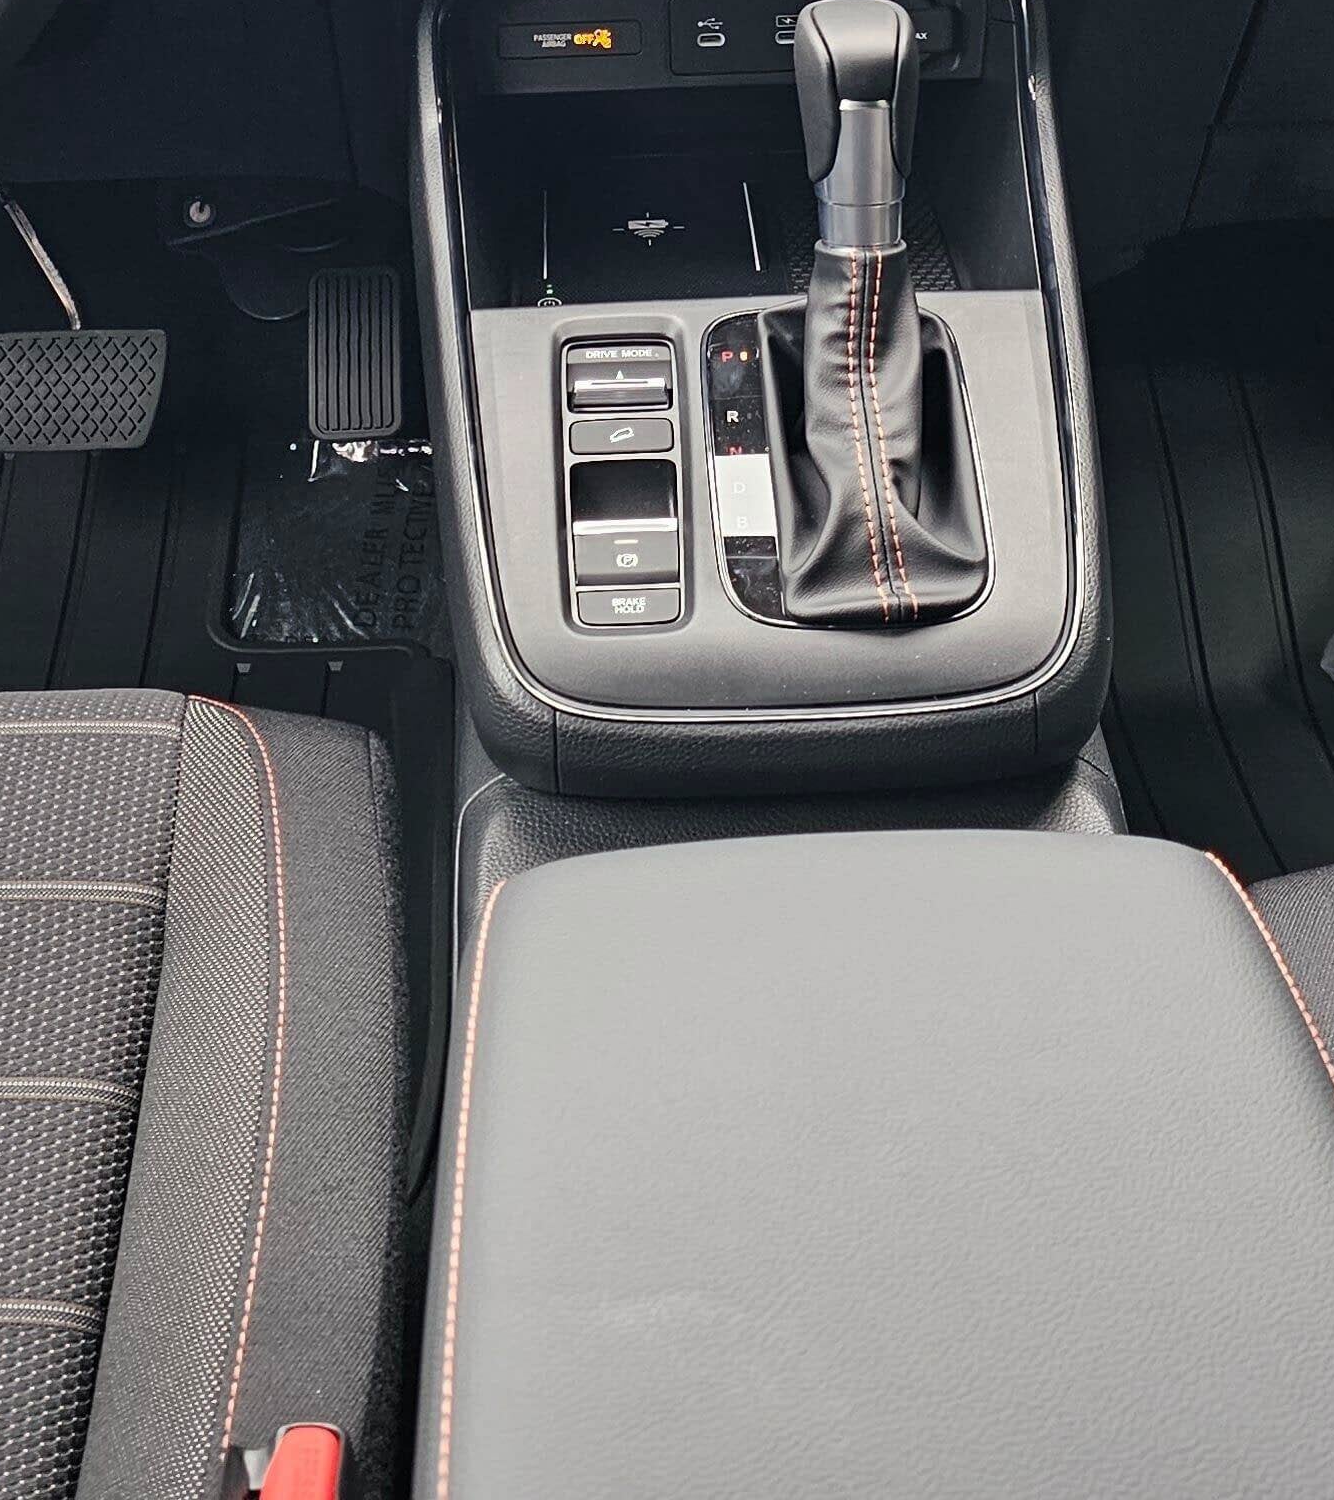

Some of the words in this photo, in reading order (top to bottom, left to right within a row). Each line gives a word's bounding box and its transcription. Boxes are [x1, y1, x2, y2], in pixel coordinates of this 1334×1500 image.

[574, 34, 595, 45] OFF
[585, 350, 618, 359] DRIVE
[621, 349, 653, 358] MODE
[721, 351, 733, 363] P
[726, 410, 739, 423] R
[733, 482, 746, 494] D
[612, 597, 646, 607] BRAKE
[614, 605, 645, 614] HOLD
